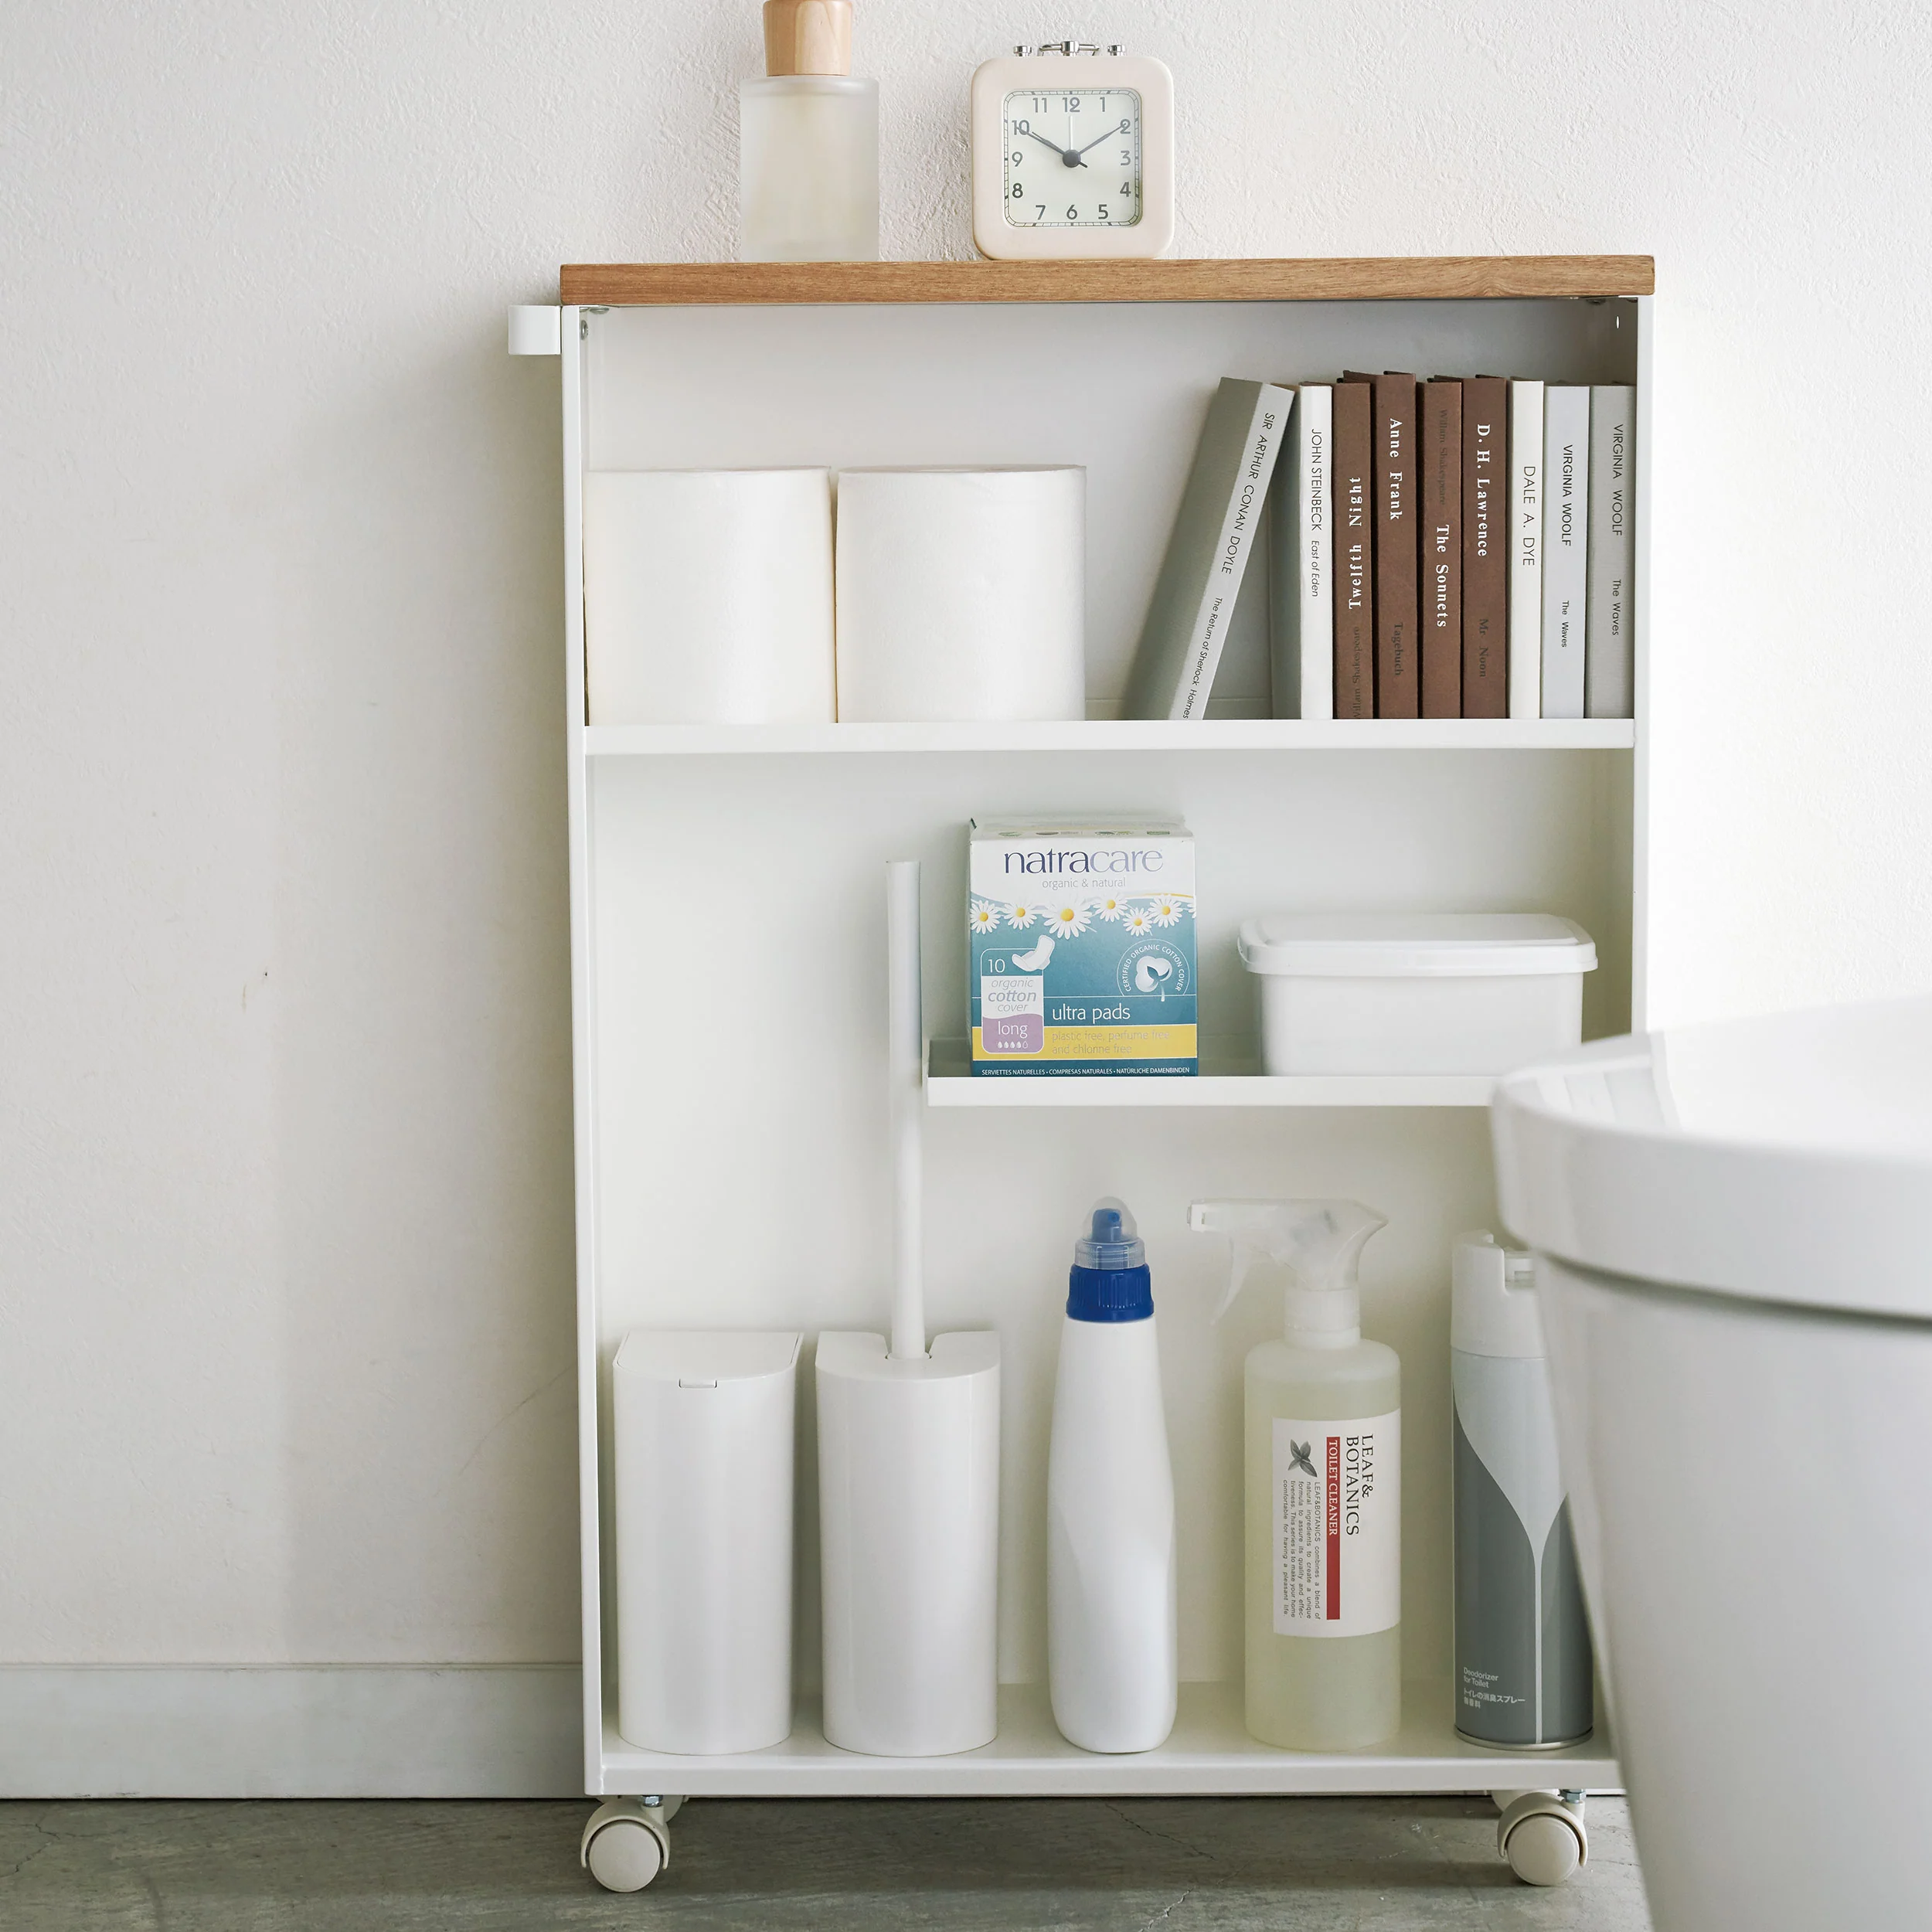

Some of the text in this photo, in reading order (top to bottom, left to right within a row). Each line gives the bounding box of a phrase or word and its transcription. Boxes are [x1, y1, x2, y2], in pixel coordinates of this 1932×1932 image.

[1032, 97, 1047, 113] 11
[1063, 97, 1080, 112] 12
[1100, 97, 1106, 112] 1
[1012, 120, 1029, 135] 10
[1121, 119, 1131, 134] 2
[1012, 151, 1023, 167] 9
[1121, 151, 1131, 165] 3
[1012, 183, 1023, 199] 8
[1120, 182, 1131, 197] 4
[1036, 205, 1046, 219] 7
[1066, 204, 1077, 219] 6
[1098, 204, 1108, 219] 5
[1389, 418, 1403, 520] Anne Frank
[1437, 448, 1447, 505] Shakespeare
[1311, 428, 1322, 531] JOHN STEINBECK
[1612, 423, 1623, 536] VIRGINIA WOOLF
[1222, 413, 1275, 574] SIR ARTHUR CONAN DOYLE
[1478, 424, 1491, 556] D. H. Lawrence
[1560, 444, 1573, 546] VIRGINIA WOOLF
[1522, 467, 1536, 566] DALE A. DYE
[1349, 477, 1362, 609] Twelfth Night
[1311, 561, 1319, 572] of
[1436, 524, 1450, 627] The Sonnets
[1612, 579, 1621, 635] The Waves
[1352, 626, 1362, 684] Shakespeare
[1392, 622, 1404, 676] Tagebuch
[1479, 619, 1488, 677] Mr Noon
[1182, 597, 1223, 719] The Return of Sherlock Holmes
[1004, 848, 1163, 873] natracare
[1043, 877, 1126, 891] organic & natural
[988, 958, 1005, 973] 10
[1122, 944, 1185, 992] CERTIFIED ORGANIC COTTON COVER
[992, 977, 1034, 990] organic
[988, 990, 1036, 1002] cotton
[998, 1004, 1028, 1012] cover
[1052, 1002, 1131, 1024] ultra pads
[998, 1021, 1028, 1039] long
[1052, 1031, 1082, 1043] plastic
[1108, 1030, 1148, 1042] perfume
[1151, 1029, 1170, 1039] free
[1052, 1045, 1070, 1054] and
[1114, 1044, 1132, 1053] free
[1362, 1434, 1373, 1498] LEAF&
[1328, 1440, 1338, 1536] TOILET CLEANER
[1346, 1436, 1359, 1535] BOTANICS
[1464, 1667, 1499, 1681] Deodorizer
[1471, 1677, 1489, 1688] Toilet
